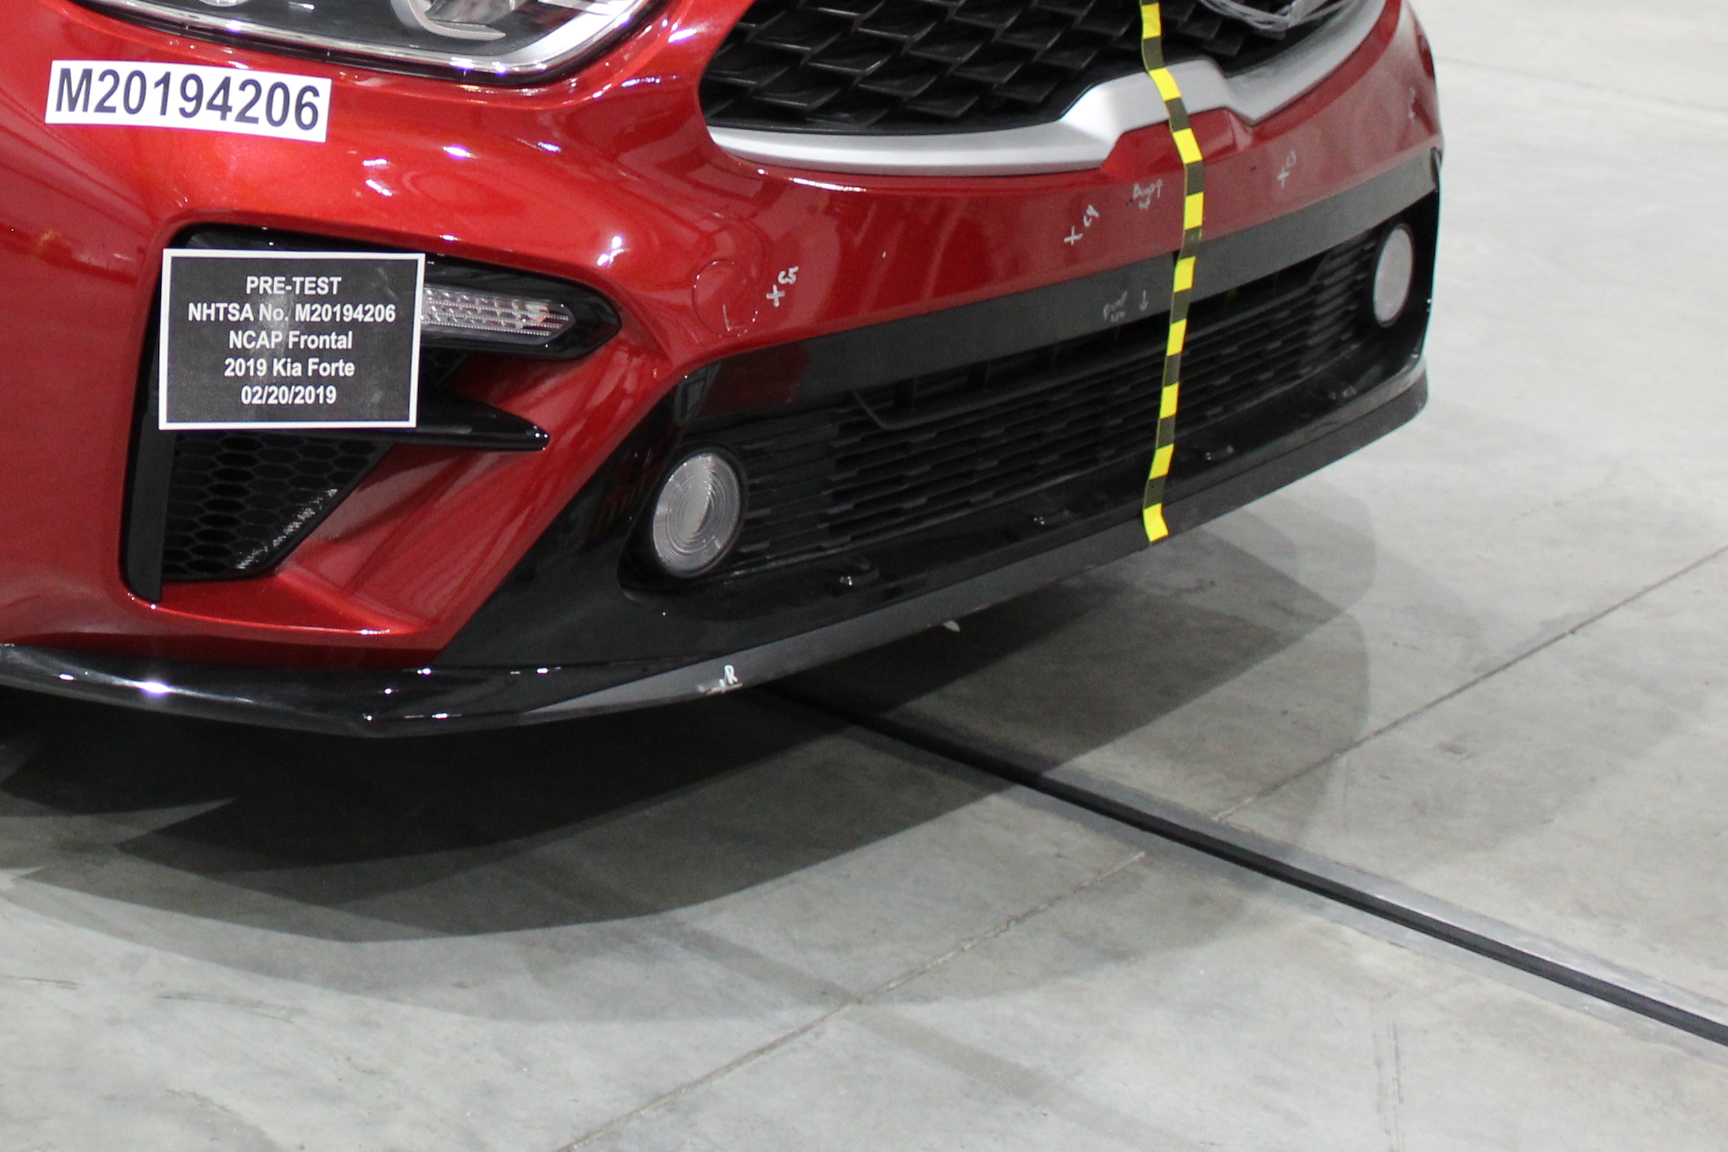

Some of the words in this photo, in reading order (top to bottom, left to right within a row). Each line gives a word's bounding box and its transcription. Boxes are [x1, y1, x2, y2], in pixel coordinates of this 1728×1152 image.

[54, 66, 321, 131] M20194206
[245, 275, 342, 295] PRE-TEST
[187, 302, 254, 322] NHTSA
[258, 303, 289, 322] No.
[294, 302, 396, 323] M20194206
[229, 330, 283, 350] NCAP
[288, 330, 353, 350] Frontal
[224, 358, 268, 377] 2019
[272, 358, 302, 377] Kia
[307, 358, 355, 377] Forte
[240, 384, 337, 406] 02/20/2019
